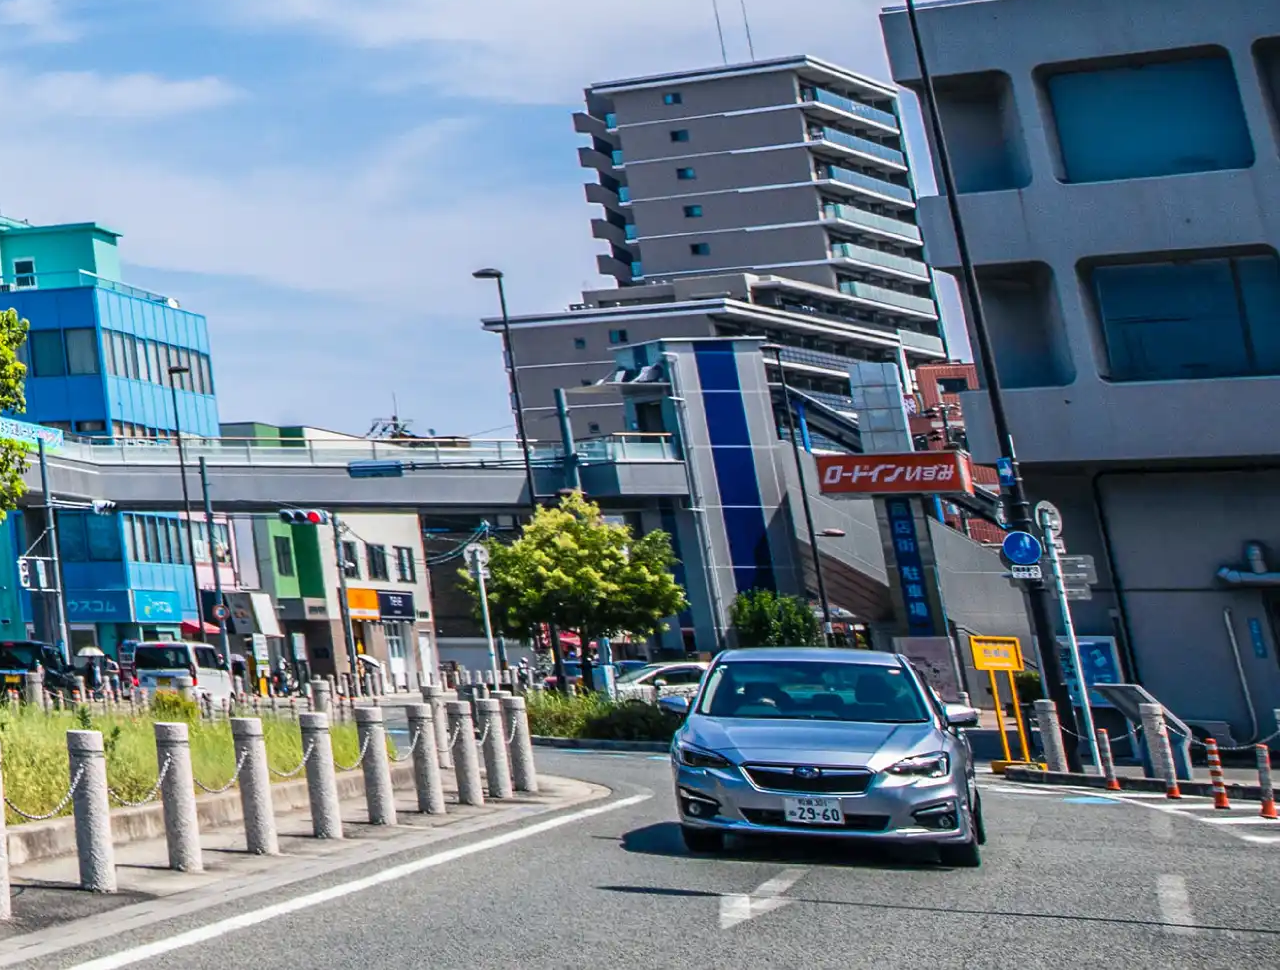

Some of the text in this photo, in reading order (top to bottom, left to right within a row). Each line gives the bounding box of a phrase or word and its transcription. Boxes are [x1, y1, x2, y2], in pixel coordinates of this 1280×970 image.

[824, 464, 954, 484] ロードインいずみ
[66, 599, 116, 612] ウスコム
[798, 807, 840, 821] 29-60
